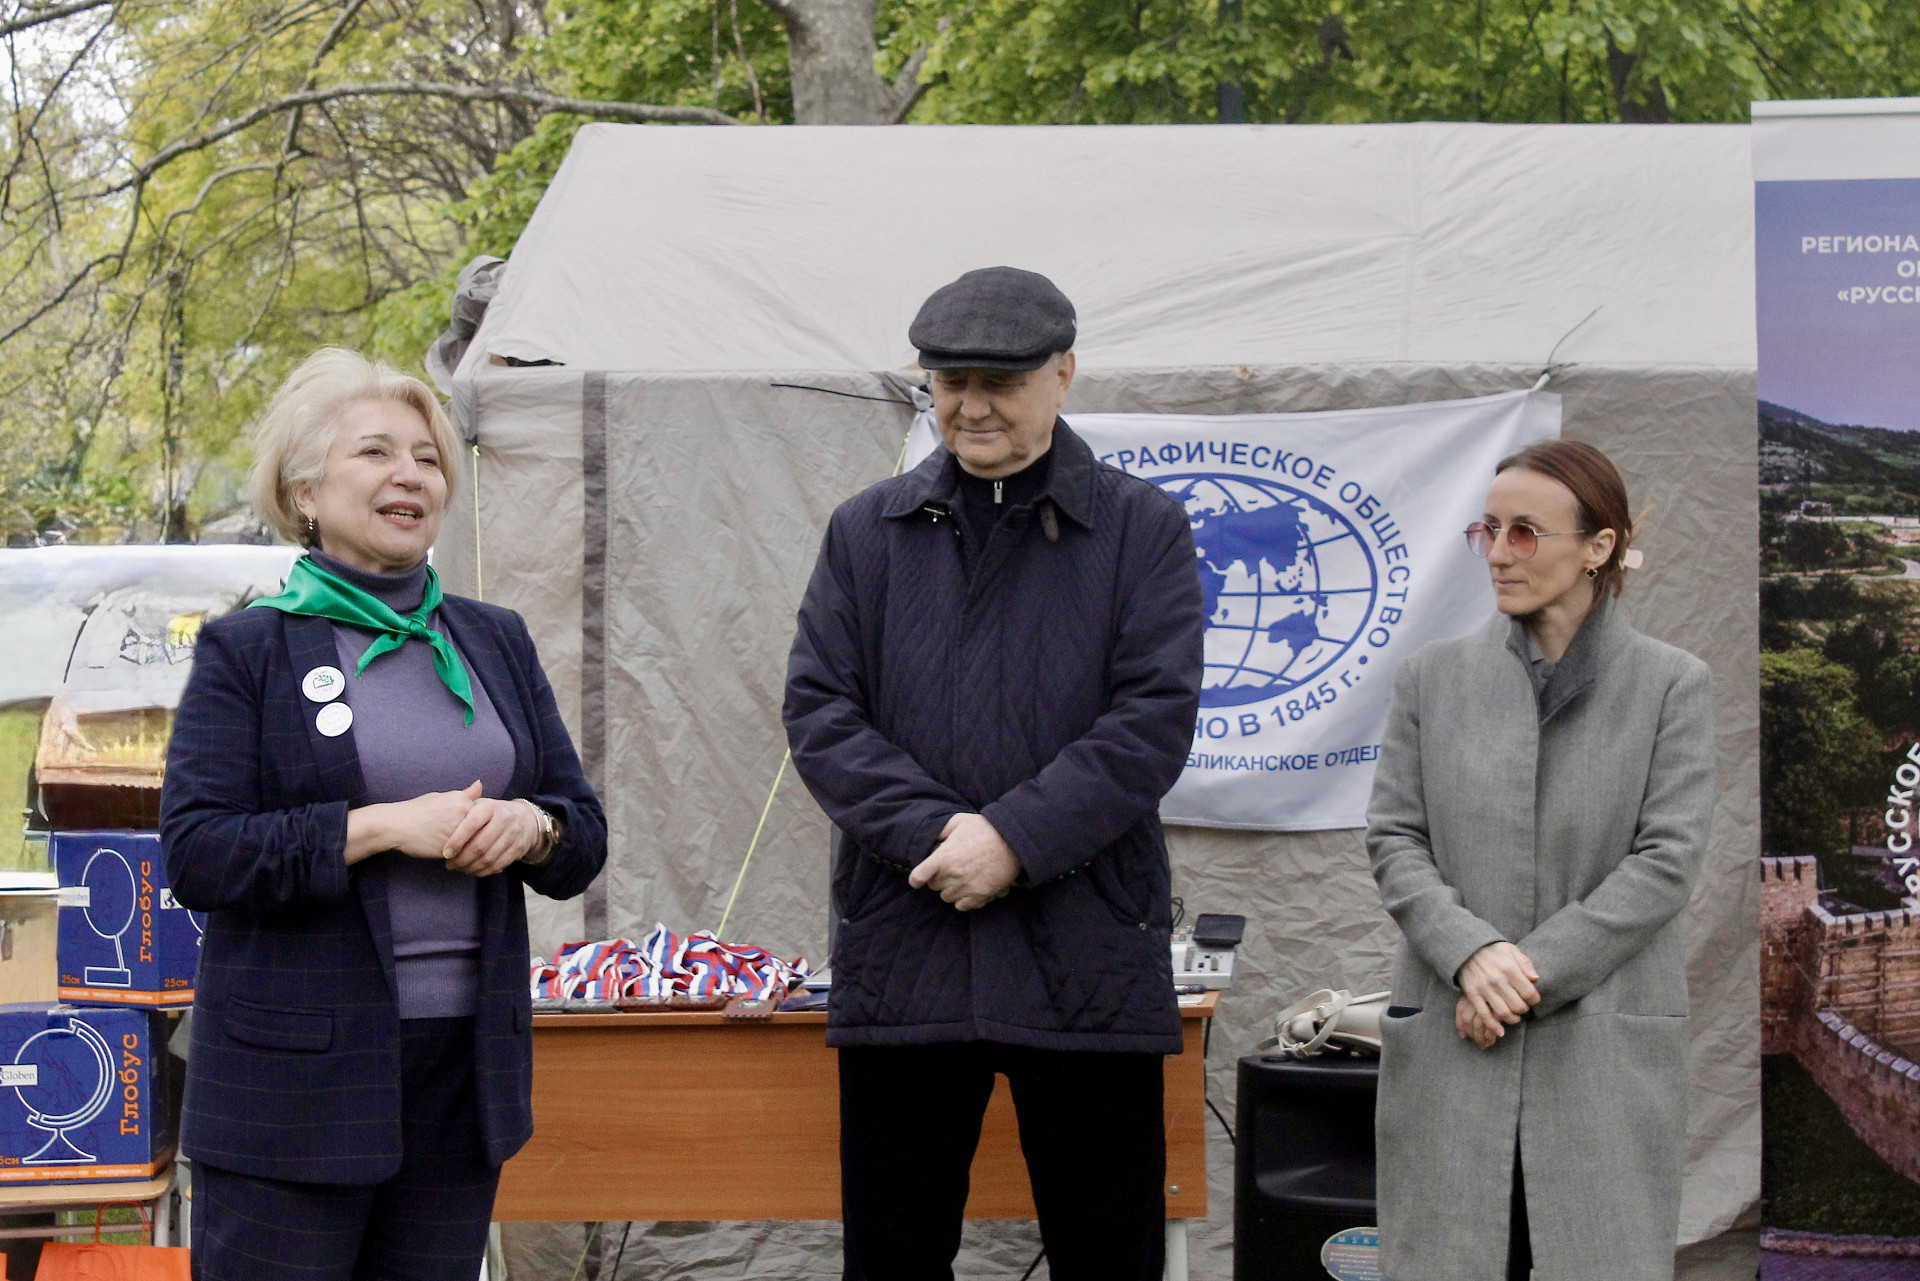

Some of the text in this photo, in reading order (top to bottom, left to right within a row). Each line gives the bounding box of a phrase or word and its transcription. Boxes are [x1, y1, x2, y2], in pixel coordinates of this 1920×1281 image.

[1801, 234, 1920, 254] РЕГИОНА
[1896, 260, 1920, 278] О
[1339, 481, 1411, 648] ОБЩЕСТВО
[1238, 713, 1262, 737] В
[1270, 681, 1338, 727] 1845
[1339, 670, 1361, 689] г.
[1185, 752, 1319, 771] БЛИКАНСКОЕ
[138, 860, 154, 964] Глобус
[163, 977, 189, 988] 25см
[118, 1032, 143, 1137] Глобус
